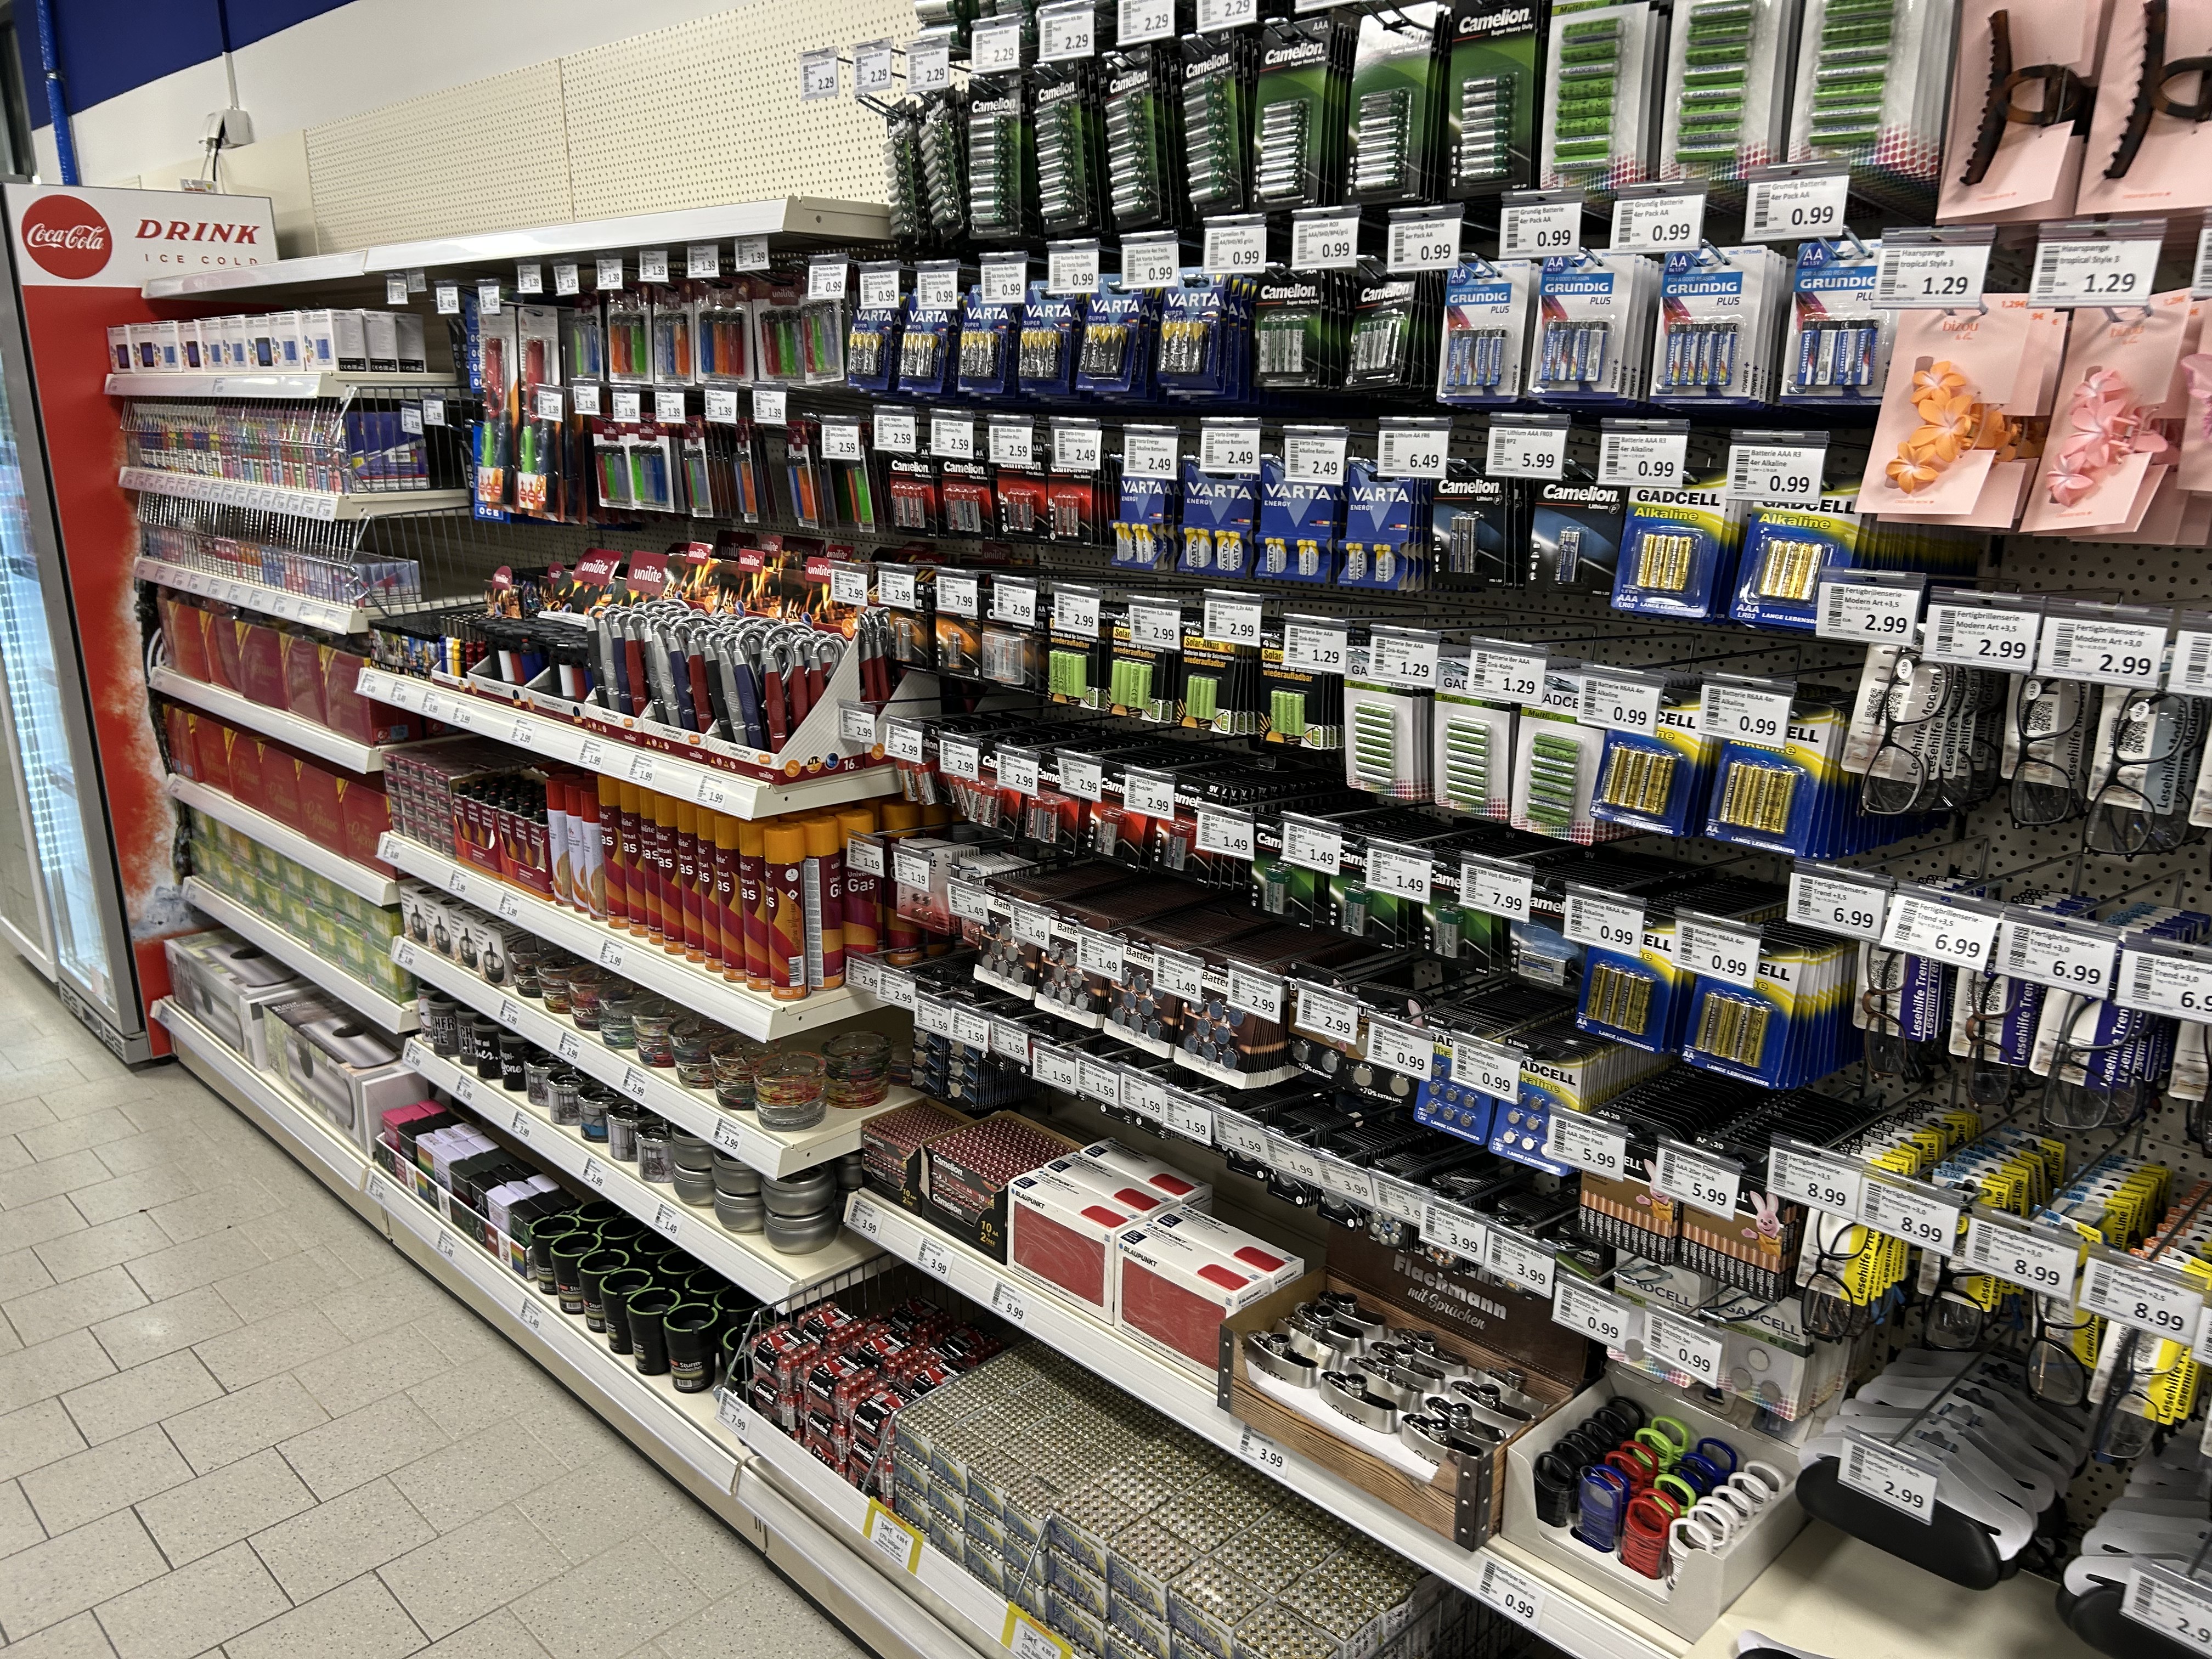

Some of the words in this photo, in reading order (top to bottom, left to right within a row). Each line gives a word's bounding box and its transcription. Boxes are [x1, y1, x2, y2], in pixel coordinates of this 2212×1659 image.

[1145, 14, 1169, 30] 2.29
[1313, 20, 1329, 31] AAA
[1459, 7, 1531, 33] Camelion
[1065, 34, 1088, 49] 2.29
[995, 47, 1014, 62] 2.29
[1265, 42, 1325, 64] Camelion
[1186, 52, 1229, 78] Camelion
[927, 68, 944, 81] 2.29
[1110, 70, 1148, 93] Camelion
[818, 76, 834, 90] 2.29
[972, 95, 1016, 113] Camelion
[1635, 200, 1657, 208] Grundig
[1792, 206, 1833, 226] 0.99
[27, 223, 104, 250] Coca-Cola
[135, 219, 261, 244] DRINK
[1537, 230, 1571, 246] 0.99
[1652, 224, 1690, 241] 0.99
[751, 252, 765, 263] 1.39
[1322, 243, 1350, 257] 0.99
[1421, 244, 1451, 260] 0.99
[1901, 249, 1945, 257] Haarspange
[145, 254, 185, 264] ICE
[201, 256, 258, 266] COLD
[1233, 251, 1259, 265] 0.99
[1669, 256, 1686, 267] AA
[1900, 260, 1927, 268] tropical
[1928, 259, 1946, 268] Style
[1149, 268, 1172, 280] 0.99
[826, 281, 842, 292] 0.99
[1544, 283, 1609, 294] GRUNDIG
[1666, 281, 1737, 294] GRUNDIG
[1922, 277, 1968, 295] 1.29
[2083, 273, 2136, 292] 1.29
[772, 290, 794, 298] unilite
[1167, 293, 1220, 307] VARTA
[1361, 283, 1409, 302] Camelion
[1449, 293, 1508, 303] GRUNDIG
[1091, 299, 1139, 313] VARTA
[1717, 296, 1740, 305] PLUS
[856, 309, 892, 321] VARTA
[1491, 305, 1510, 313] PLUS
[1943, 320, 1978, 332] bizou
[719, 407, 732, 416] 1.39
[894, 433, 911, 444] 2.59
[839, 442, 855, 453] 2.59
[1009, 445, 1027, 457] 2.59
[1148, 458, 1170, 470] 2.49
[1228, 452, 1252, 464] 2.49
[1410, 454, 1439, 468] 6.49
[1522, 453, 1554, 468] 5.99
[891, 461, 929, 472] Camelion
[944, 461, 985, 475] Camelion
[1638, 461, 1674, 477] 0.99
[1187, 482, 1252, 499] VARTA
[1438, 479, 1501, 494] Camelion
[1769, 476, 1809, 493] 0.99
[1352, 487, 1409, 503] VARTA
[1543, 484, 1620, 503] Camelion
[1637, 490, 1720, 507] GADCELL
[1634, 507, 1699, 521] Alkaline
[1758, 513, 1831, 529] Alkaline
[580, 560, 608, 575] unilite
[740, 555, 760, 567] unilite
[634, 567, 662, 583] unilite
[848, 588, 863, 599] 2.99
[1617, 595, 1638, 603] AAA
[1845, 586, 1902, 599] Fertigbrillenserie
[956, 595, 972, 607] 7.99
[1844, 597, 1870, 607] Modern
[1230, 623, 1254, 637] 2.99
[1865, 614, 1907, 634] 2.99
[1186, 636, 1220, 650] Solar-Akkus
[1979, 639, 2026, 659] 2.99
[1312, 650, 1339, 663] 1.29
[1262, 669, 1313, 683] wiederaufladbar
[1503, 678, 1535, 694] 1.29
[1613, 707, 1647, 725] 0.99
[1740, 716, 1776, 735] 0.99
[902, 744, 918, 755] 2.99
[1080, 779, 1097, 793] 2.99
[709, 792, 723, 804] 1.99
[1223, 836, 1248, 850] 1.49
[864, 859, 879, 869] 1.19
[848, 878, 874, 892] Gas
[1396, 876, 1423, 891] 1.49
[1493, 893, 1522, 911] 7.99
[1833, 907, 1874, 928] 6.99
[1918, 912, 1936, 922] Trend
[1600, 926, 1633, 945] 0.99
[1935, 934, 1980, 958] 6.99
[610, 955, 622, 966] 1.99
[1712, 955, 1747, 976] 0.99
[2052, 961, 2100, 984] 6.99
[895, 991, 912, 1003] 2.99
[1910, 994, 1923, 1036] Lesehilfe
[1325, 1017, 1351, 1034] 2.99
[968, 1031, 984, 1043] 1.59
[1397, 1052, 1425, 1070] 0.99
[1053, 1070, 1071, 1085] 1.59
[1141, 1098, 1160, 1113] 1.59
[724, 1135, 738, 1149] 2.99
[933, 1154, 963, 1176] Camelion
[1582, 1149, 1616, 1168] 5.99
[1290, 1161, 1314, 1177] 1.99
[1015, 1191, 1045, 1209] BLAUPUNKT
[1807, 1183, 1846, 1206] 8.99
[980, 1221, 992, 1232] 10
[1901, 1217, 1943, 1243] 8.99
[1450, 1234, 1477, 1252] 3.99
[1124, 1245, 1157, 1267] BLAUPUNKT
[930, 1260, 947, 1273] 3.99
[1517, 1264, 1546, 1285] 3.99
[1393, 1255, 1506, 1320] Flachmann
[1006, 1304, 1024, 1318] 9.99
[1407, 1287, 1427, 1304] mit
[1427, 1293, 1485, 1330] Sprüchen
[2134, 1303, 2184, 1331] 8.99
[1679, 1348, 1711, 1373] 0.99
[731, 1414, 746, 1431] 7.99
[1260, 1448, 1283, 1466] 3.99
[972, 1471, 996, 1493] GADCELL
[1883, 1480, 1923, 1509] 2.99
[1052, 1513, 1080, 1534] GADCELL
[1505, 1594, 1534, 1618] 0.99
